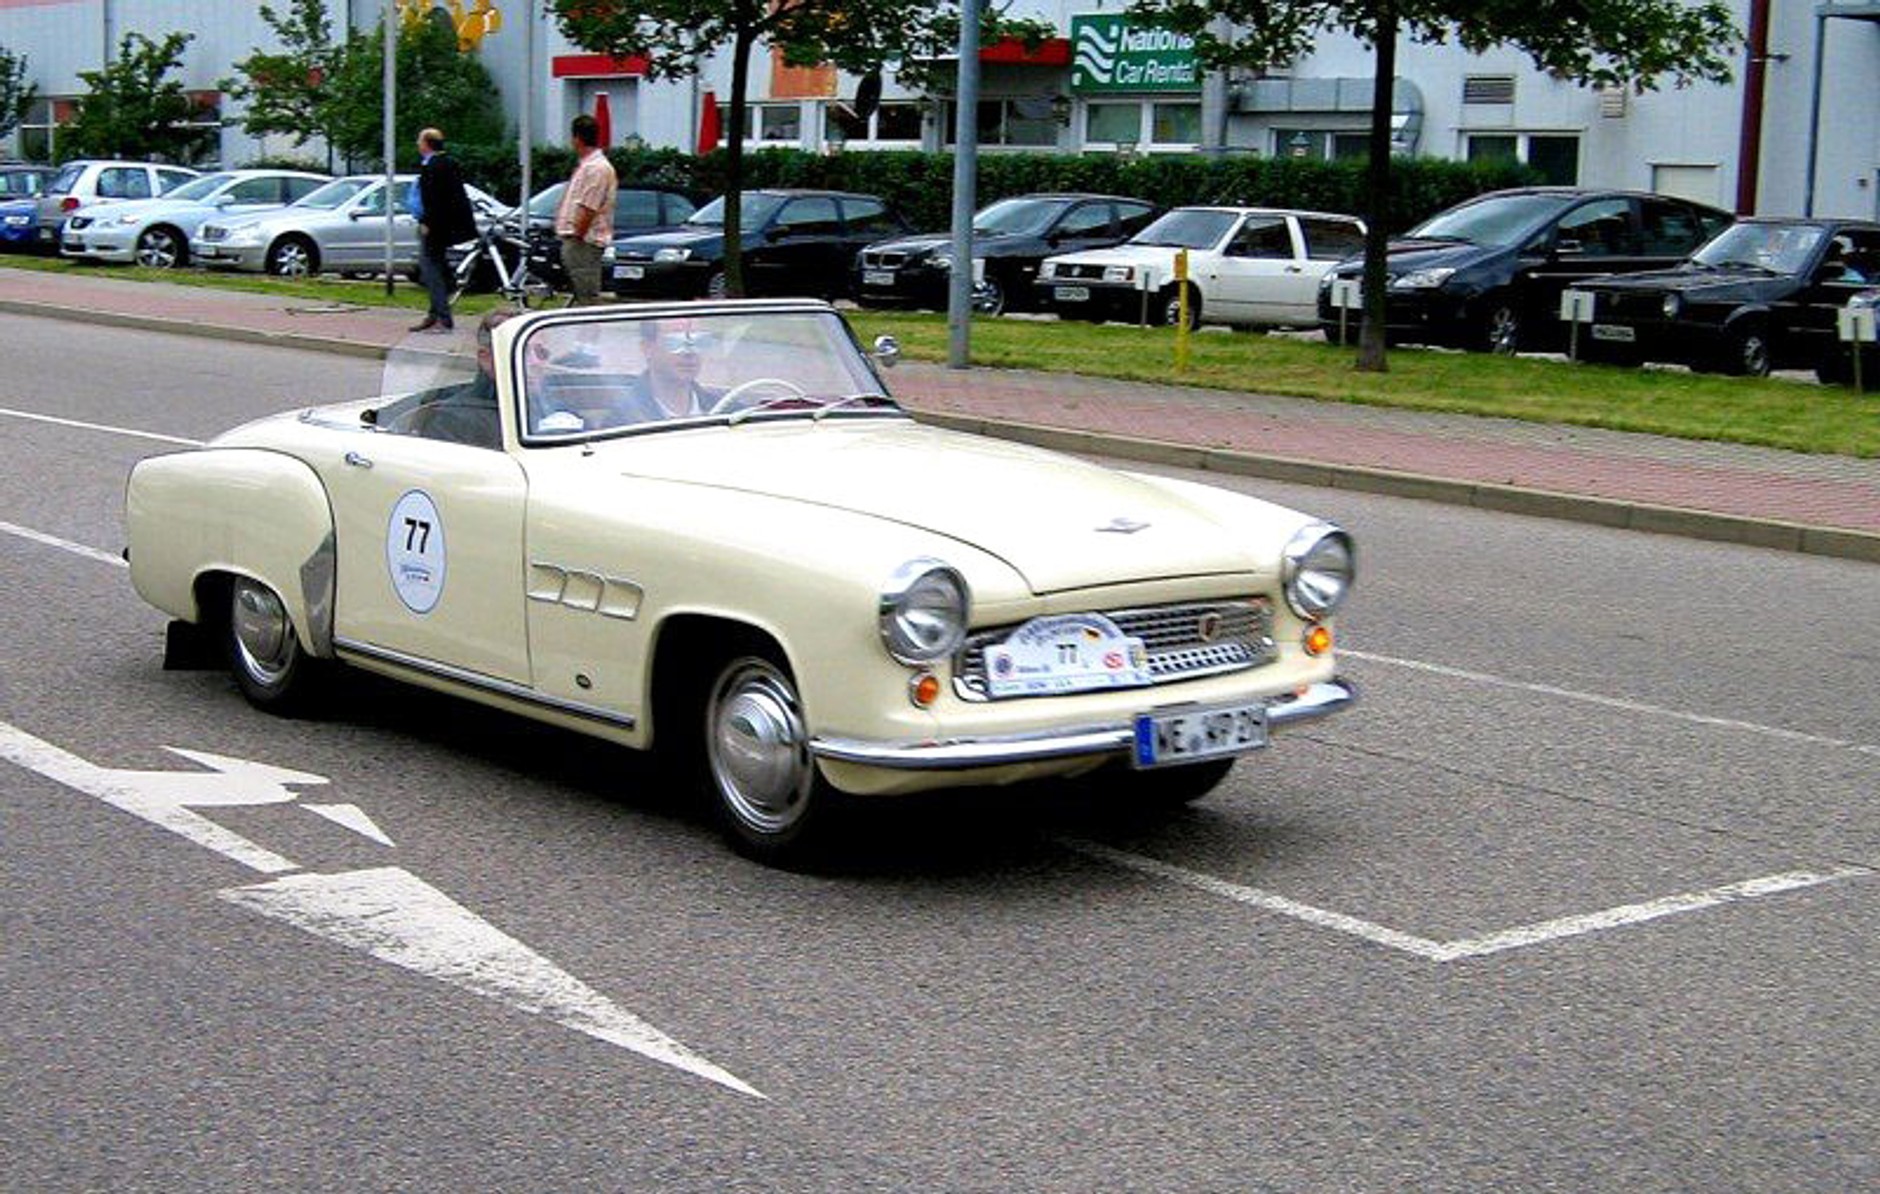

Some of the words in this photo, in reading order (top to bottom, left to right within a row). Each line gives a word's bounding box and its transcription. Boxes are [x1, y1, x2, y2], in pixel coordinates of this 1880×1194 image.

[1120, 26, 1195, 52] Nationa
[1116, 60, 1144, 83] Car
[1143, 59, 1198, 83] Rental
[405, 517, 431, 554] 77
[1056, 644, 1078, 664] 77
